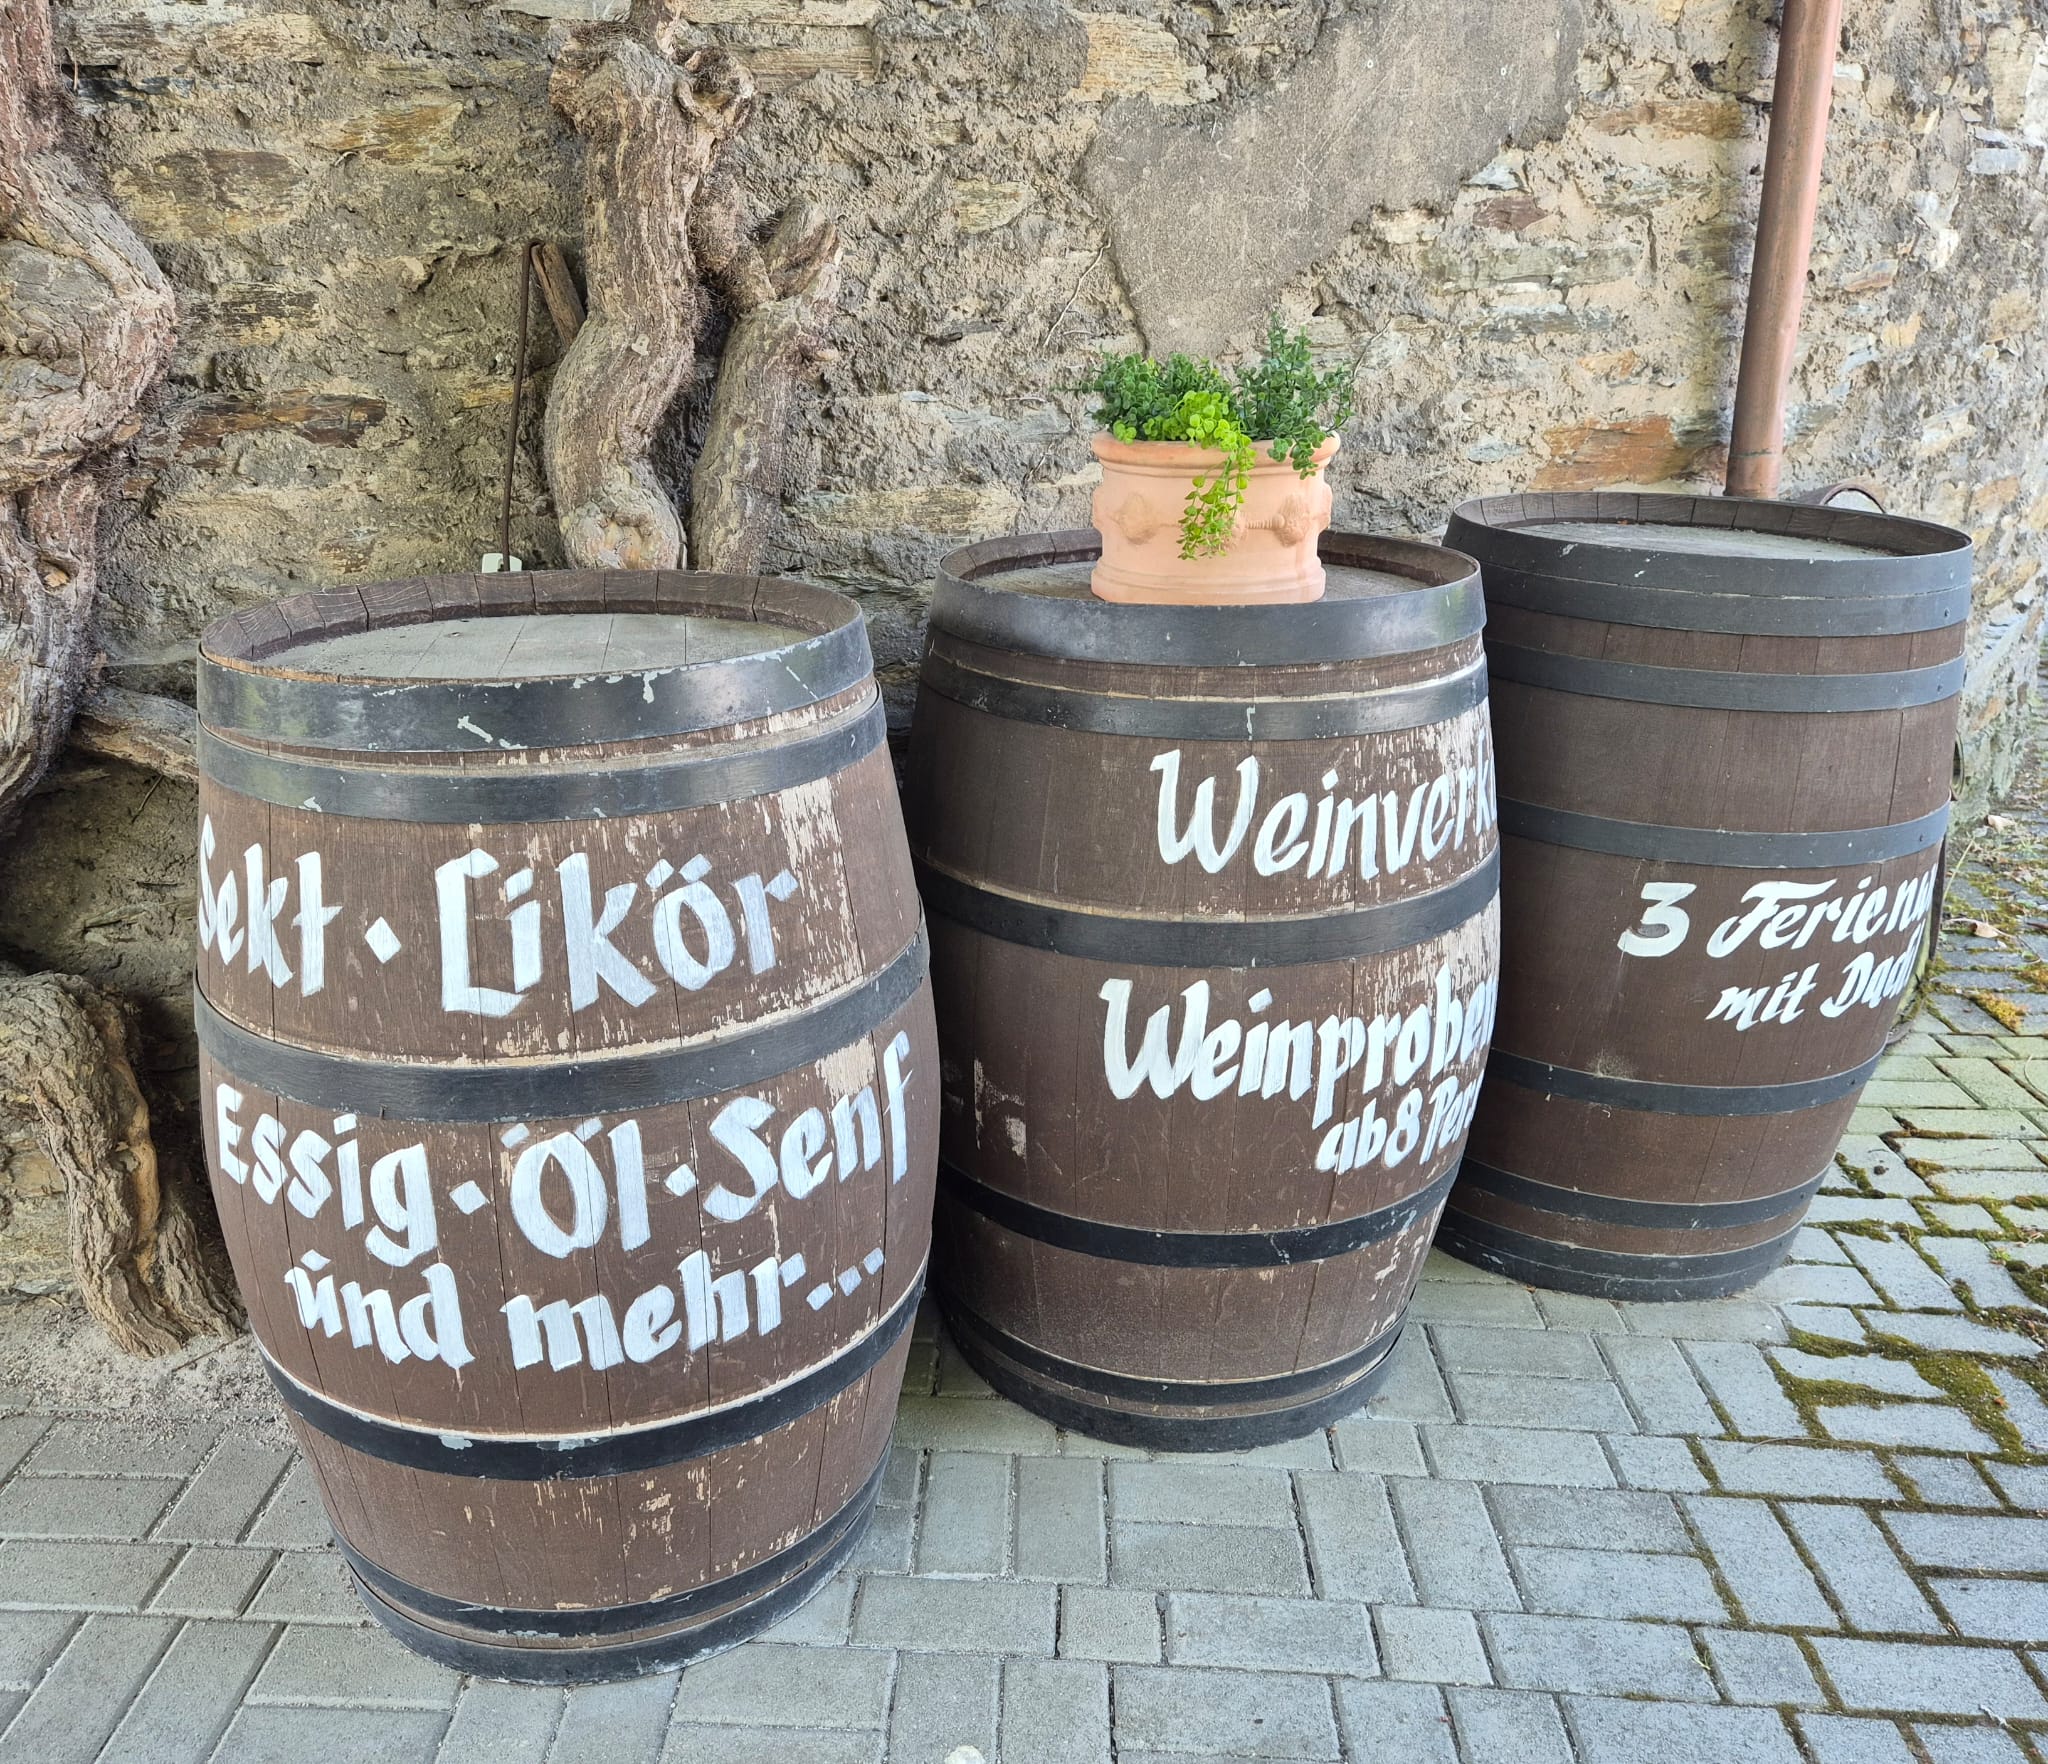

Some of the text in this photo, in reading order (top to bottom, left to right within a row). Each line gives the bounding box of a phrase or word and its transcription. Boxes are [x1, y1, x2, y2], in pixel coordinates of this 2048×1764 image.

[199, 813, 799, 1018] Sekt Likör
[1617, 881, 1697, 958] 3
[1705, 962, 1820, 1032] mit
[216, 1029, 914, 1268] Essig Öl Senf
